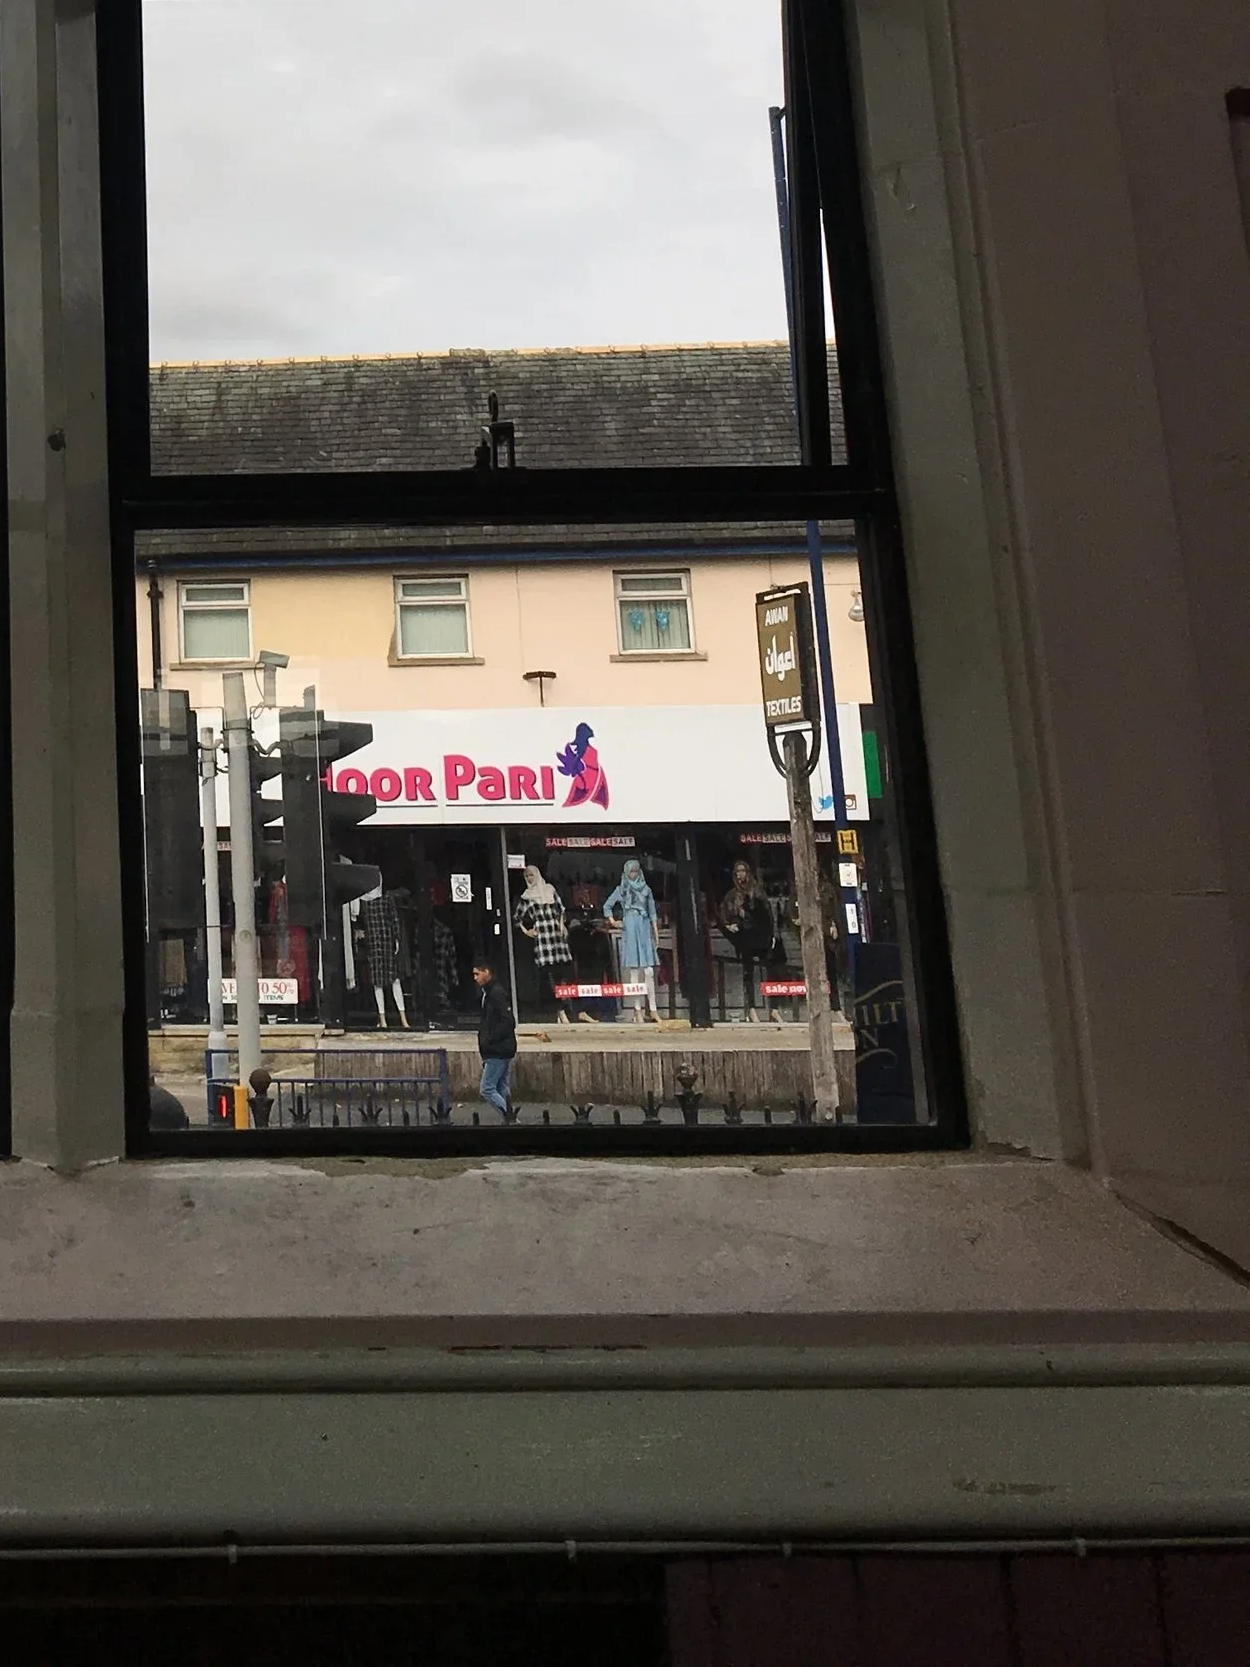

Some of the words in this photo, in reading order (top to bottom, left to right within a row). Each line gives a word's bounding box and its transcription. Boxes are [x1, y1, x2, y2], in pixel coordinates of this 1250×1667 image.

[765, 606, 788, 626] AWAN
[766, 696, 802, 716] TEXTILES
[546, 838, 567, 846] SALE
[591, 838, 611, 846] SALE
[741, 834, 762, 842] SALE
[558, 987, 576, 996] sale
[581, 987, 598, 995] sale
[603, 985, 621, 994] sale
[627, 984, 644, 992] sale
[765, 984, 788, 994] sale
